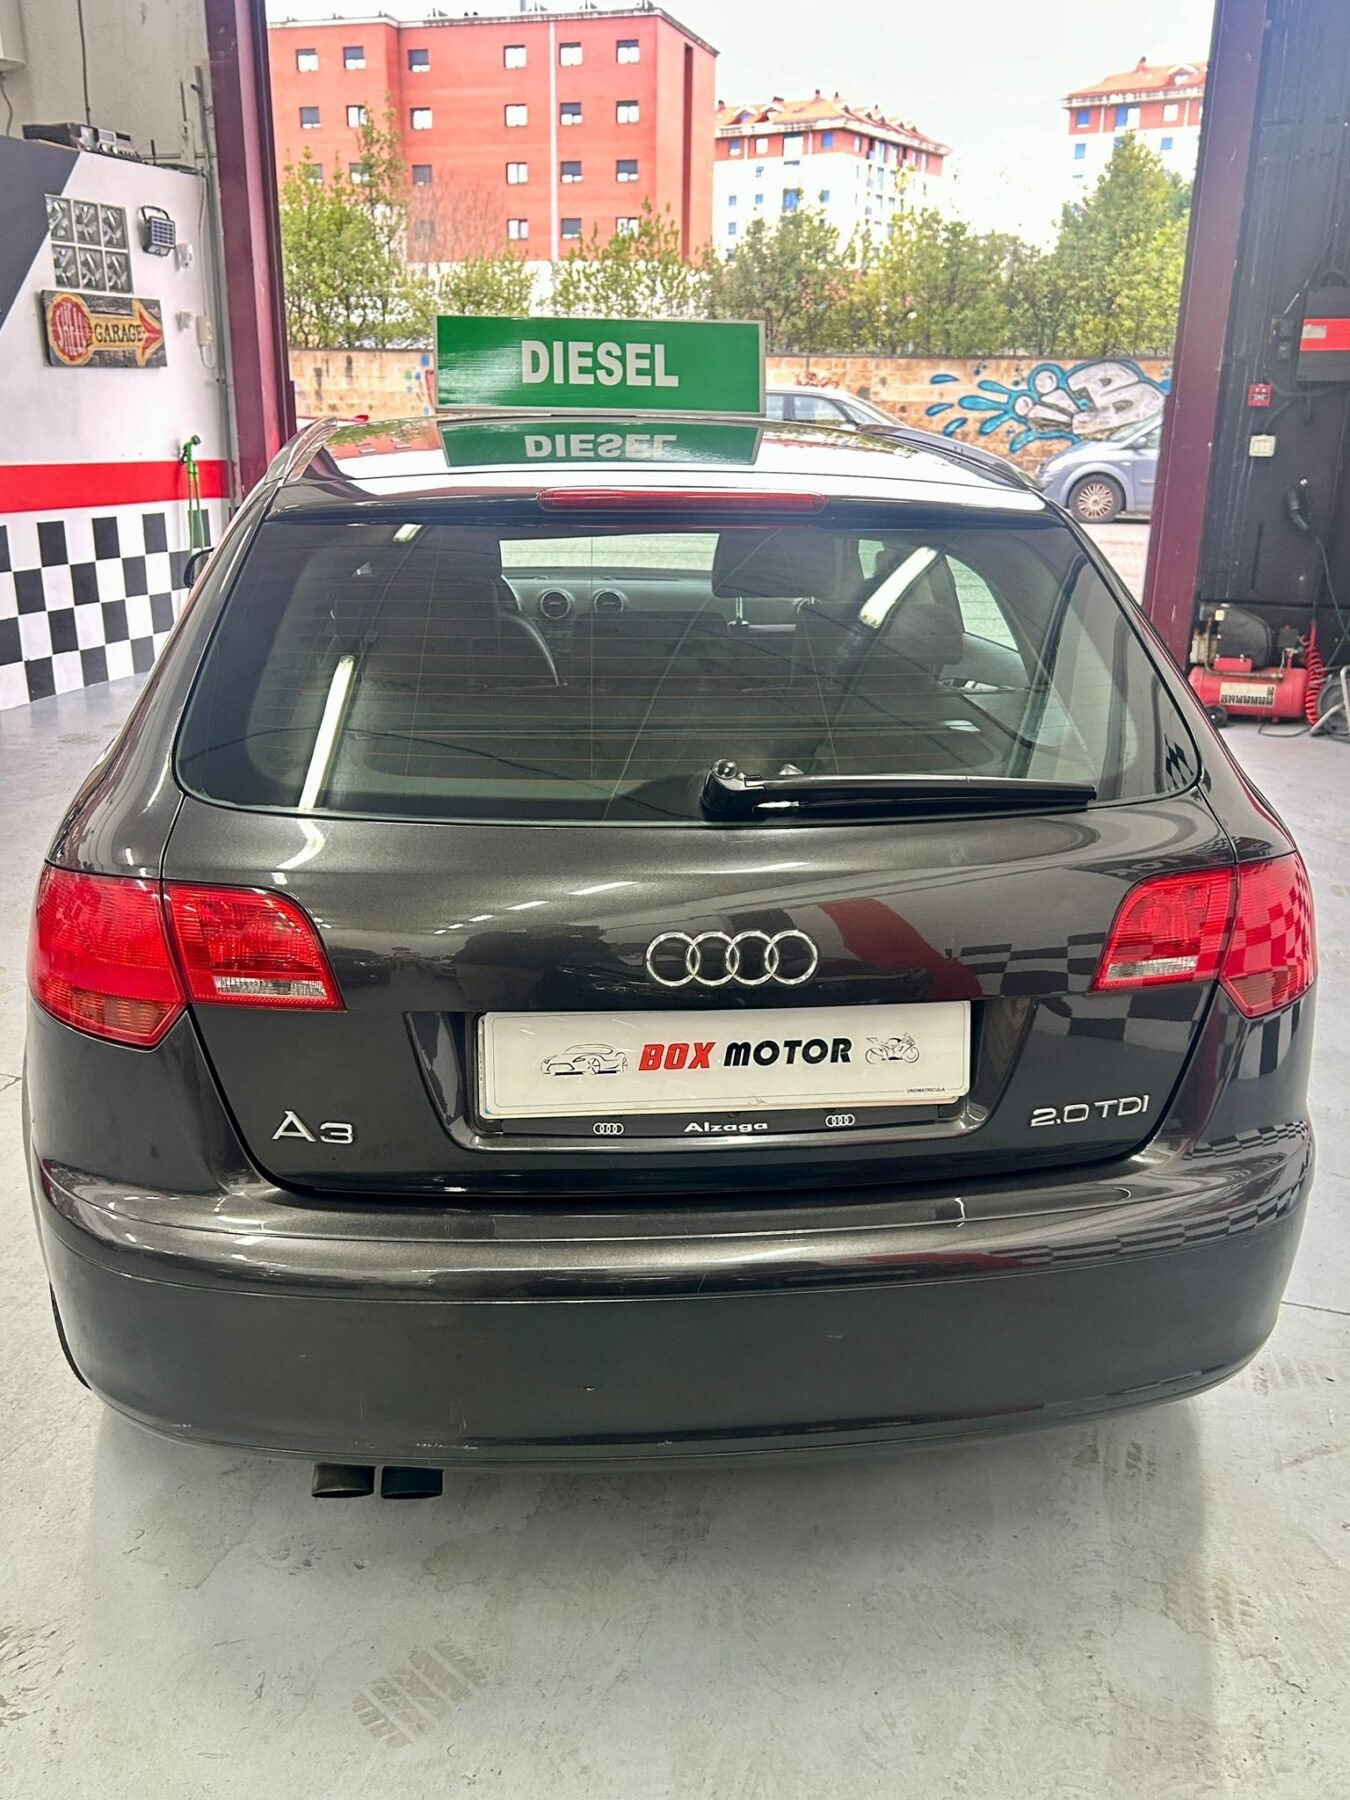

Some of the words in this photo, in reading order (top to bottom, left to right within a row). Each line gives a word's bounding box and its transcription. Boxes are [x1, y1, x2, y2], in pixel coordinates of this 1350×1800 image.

[94, 324, 143, 342] GARAGE
[521, 340, 679, 387] DIESEL
[638, 1042, 716, 1071] BOX
[723, 1038, 852, 1066] MOTOR
[271, 1110, 354, 1144] A3
[684, 1121, 768, 1133] Alzaga
[1030, 1103, 1090, 1127] 2.0
[1093, 1094, 1150, 1118] TDI
